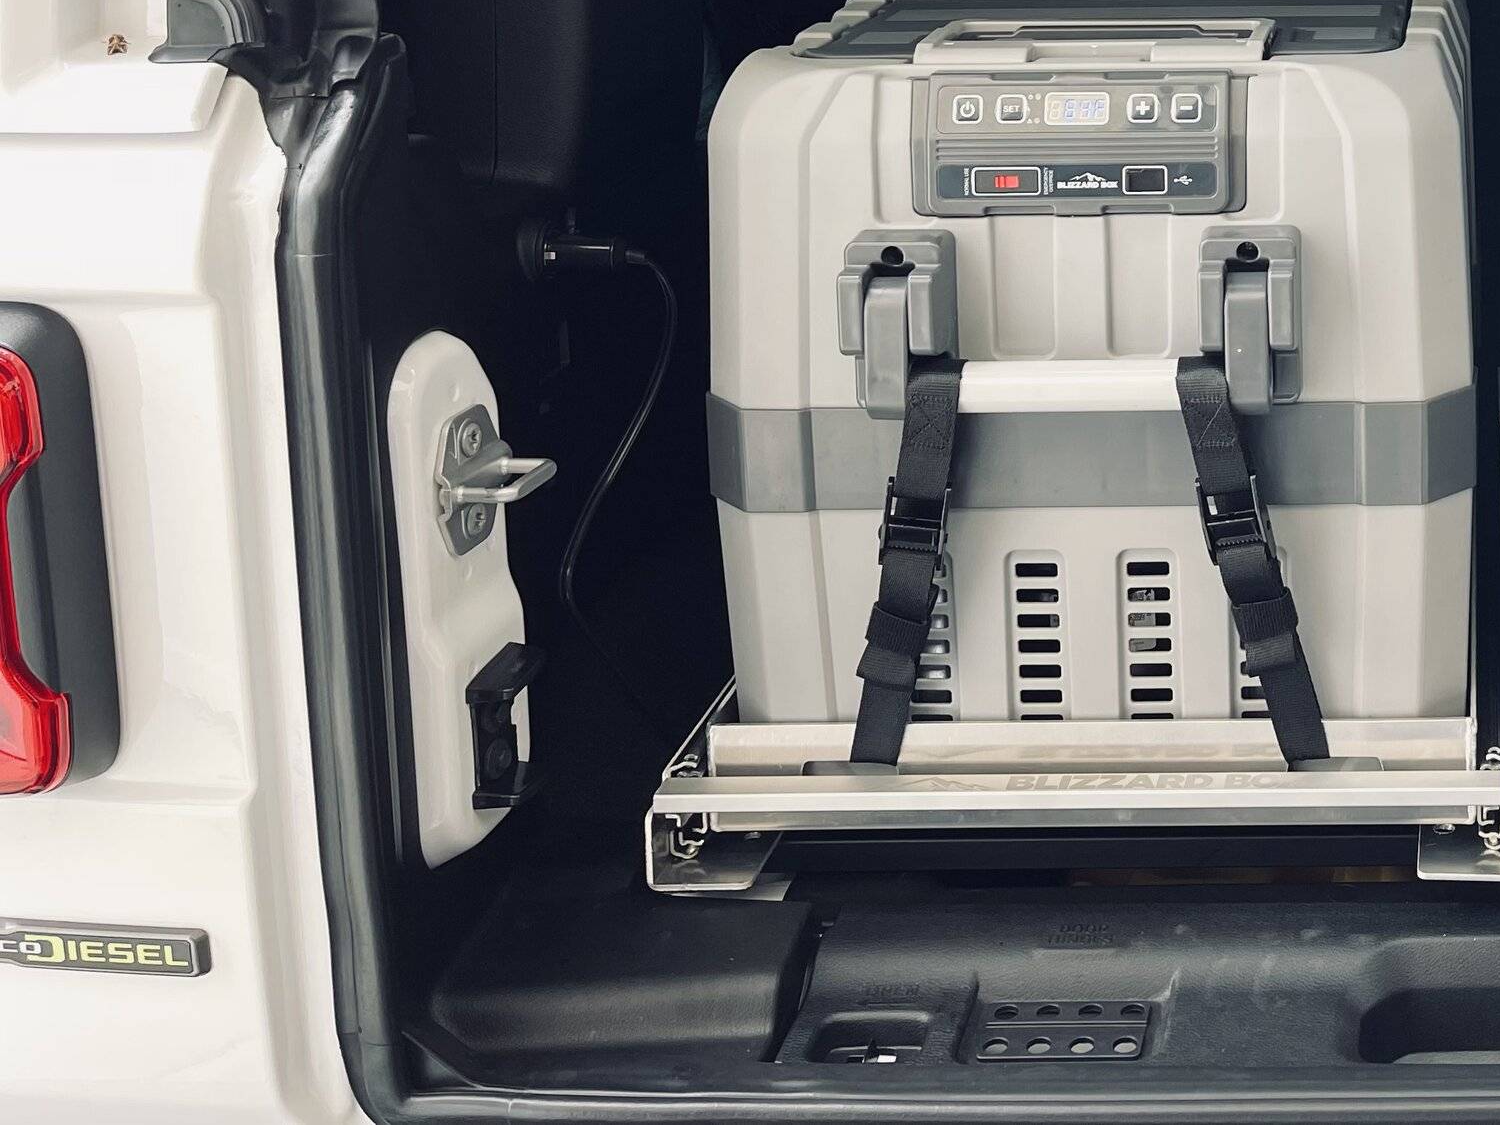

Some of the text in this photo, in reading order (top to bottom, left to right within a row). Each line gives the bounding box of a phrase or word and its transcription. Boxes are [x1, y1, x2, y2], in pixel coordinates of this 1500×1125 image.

[1003, 105, 1020, 113] SET
[1056, 181, 1118, 189] BLIZZARD BOX
[1006, 774, 1213, 791] BLIZZARD
